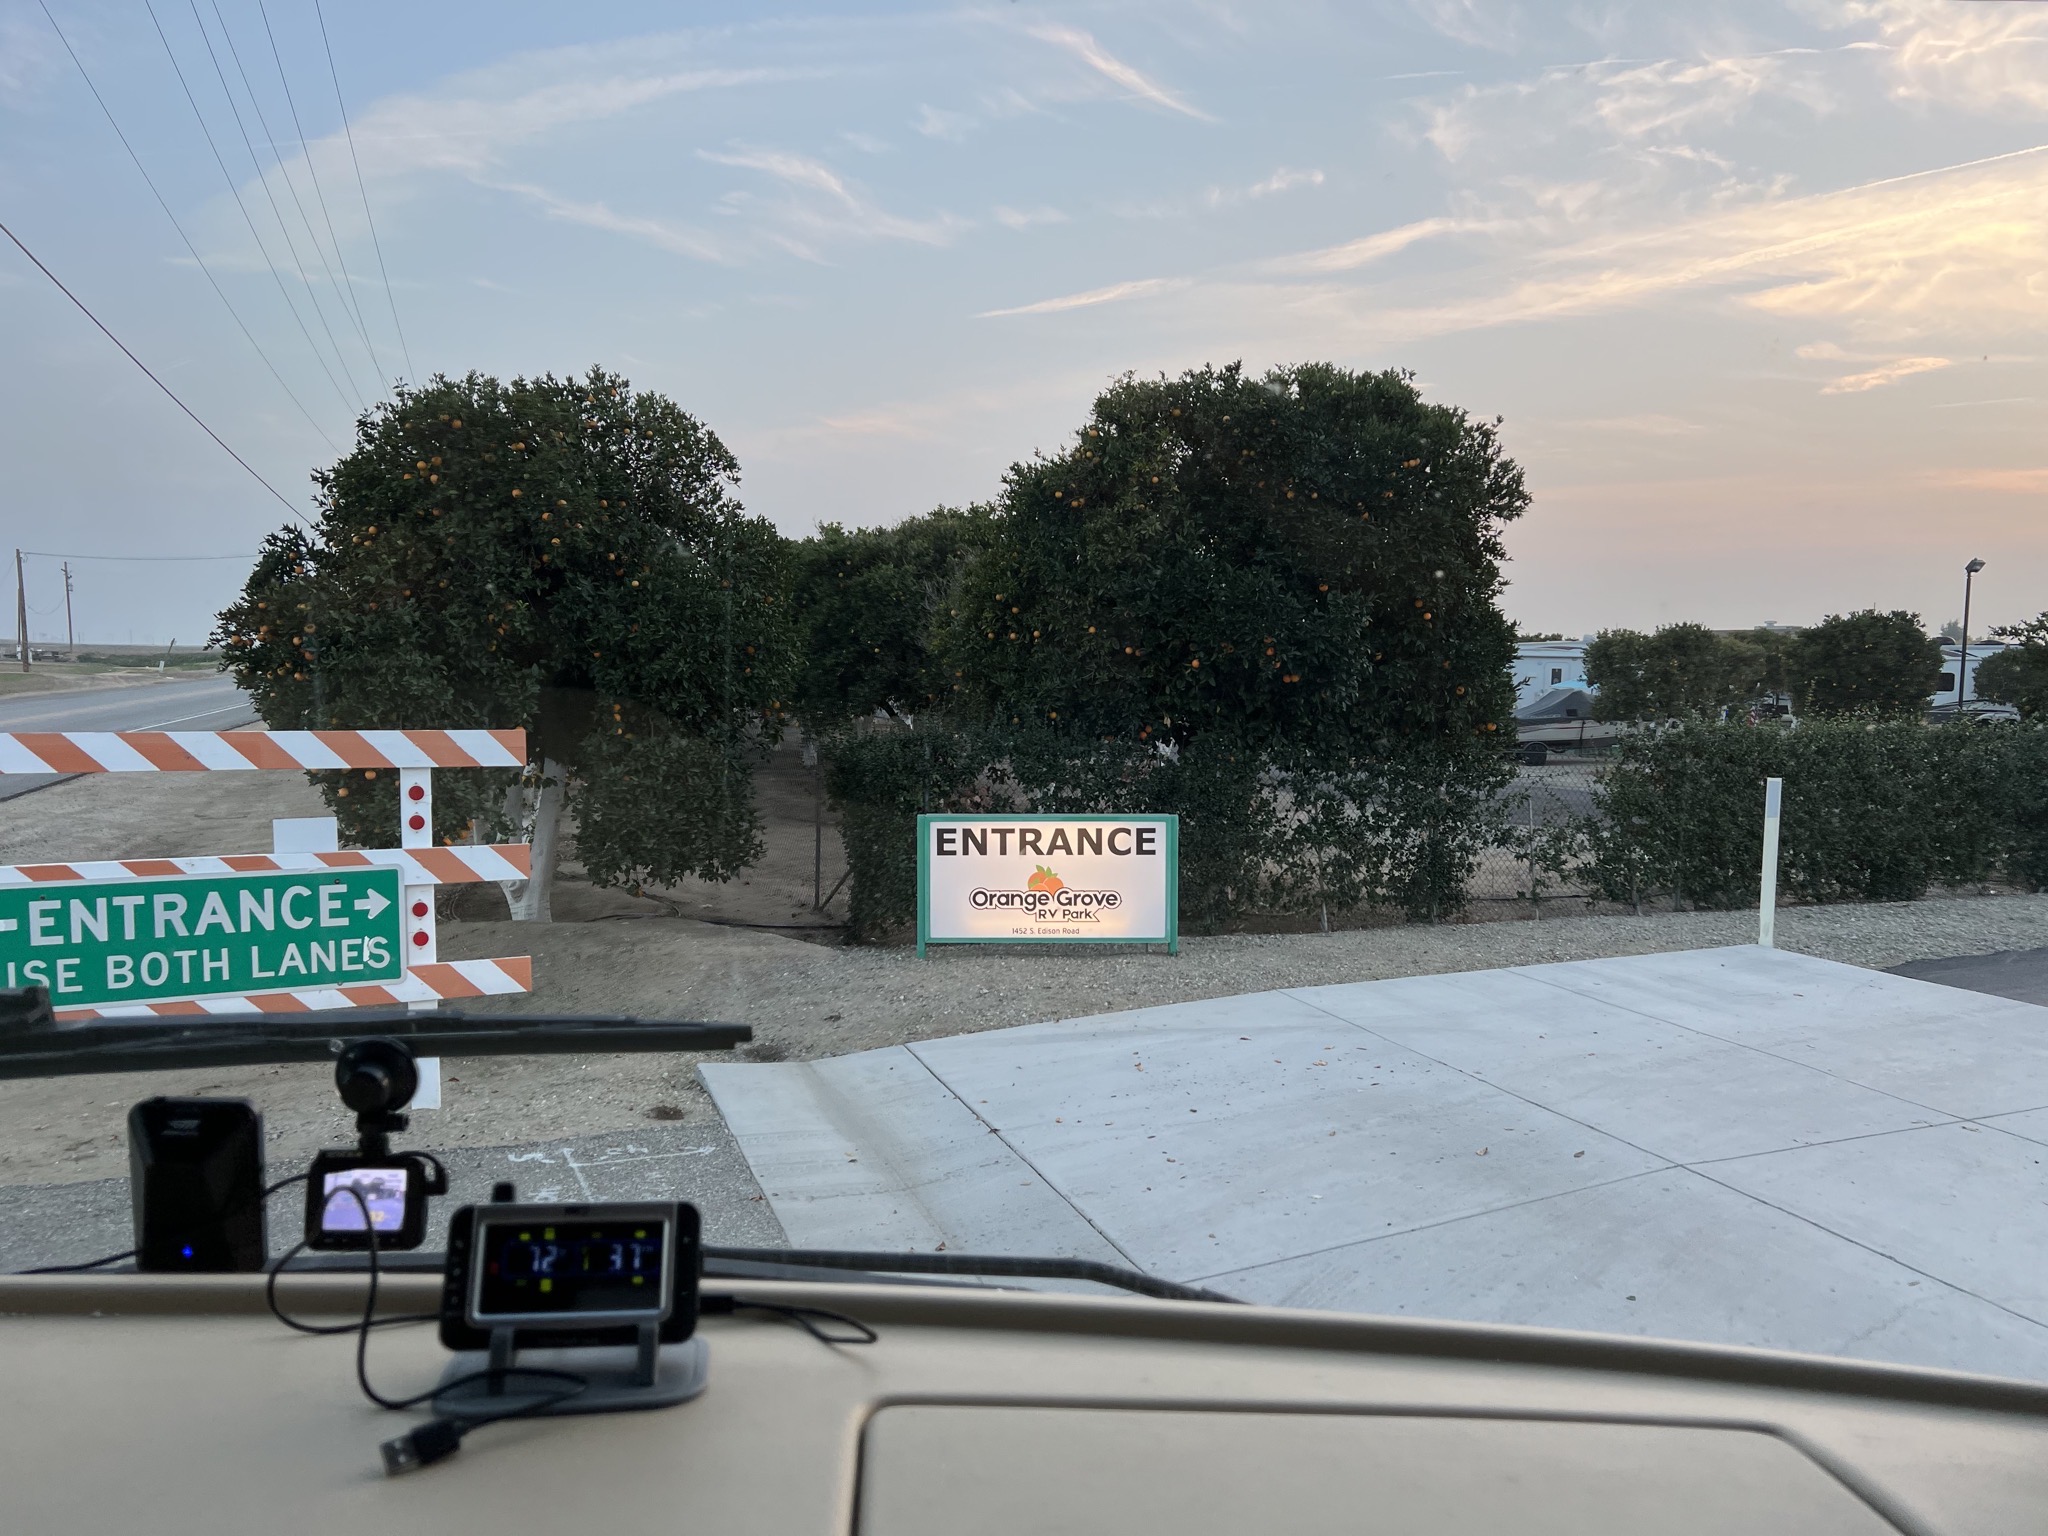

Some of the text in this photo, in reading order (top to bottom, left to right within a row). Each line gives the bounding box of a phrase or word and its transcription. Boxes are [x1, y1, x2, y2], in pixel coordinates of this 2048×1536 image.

[936, 828, 1156, 856] ENTRANCE
[972, 893, 1118, 911] Orange Grove
[1038, 908, 1092, 919] RV Park
[28, 884, 350, 946] ENTRANCE
[1012, 927, 1027, 935] 1452
[1037, 927, 1061, 935] Edison
[1062, 927, 1080, 935] Road
[107, 948, 229, 989] BOTH
[250, 937, 390, 978] LANES
